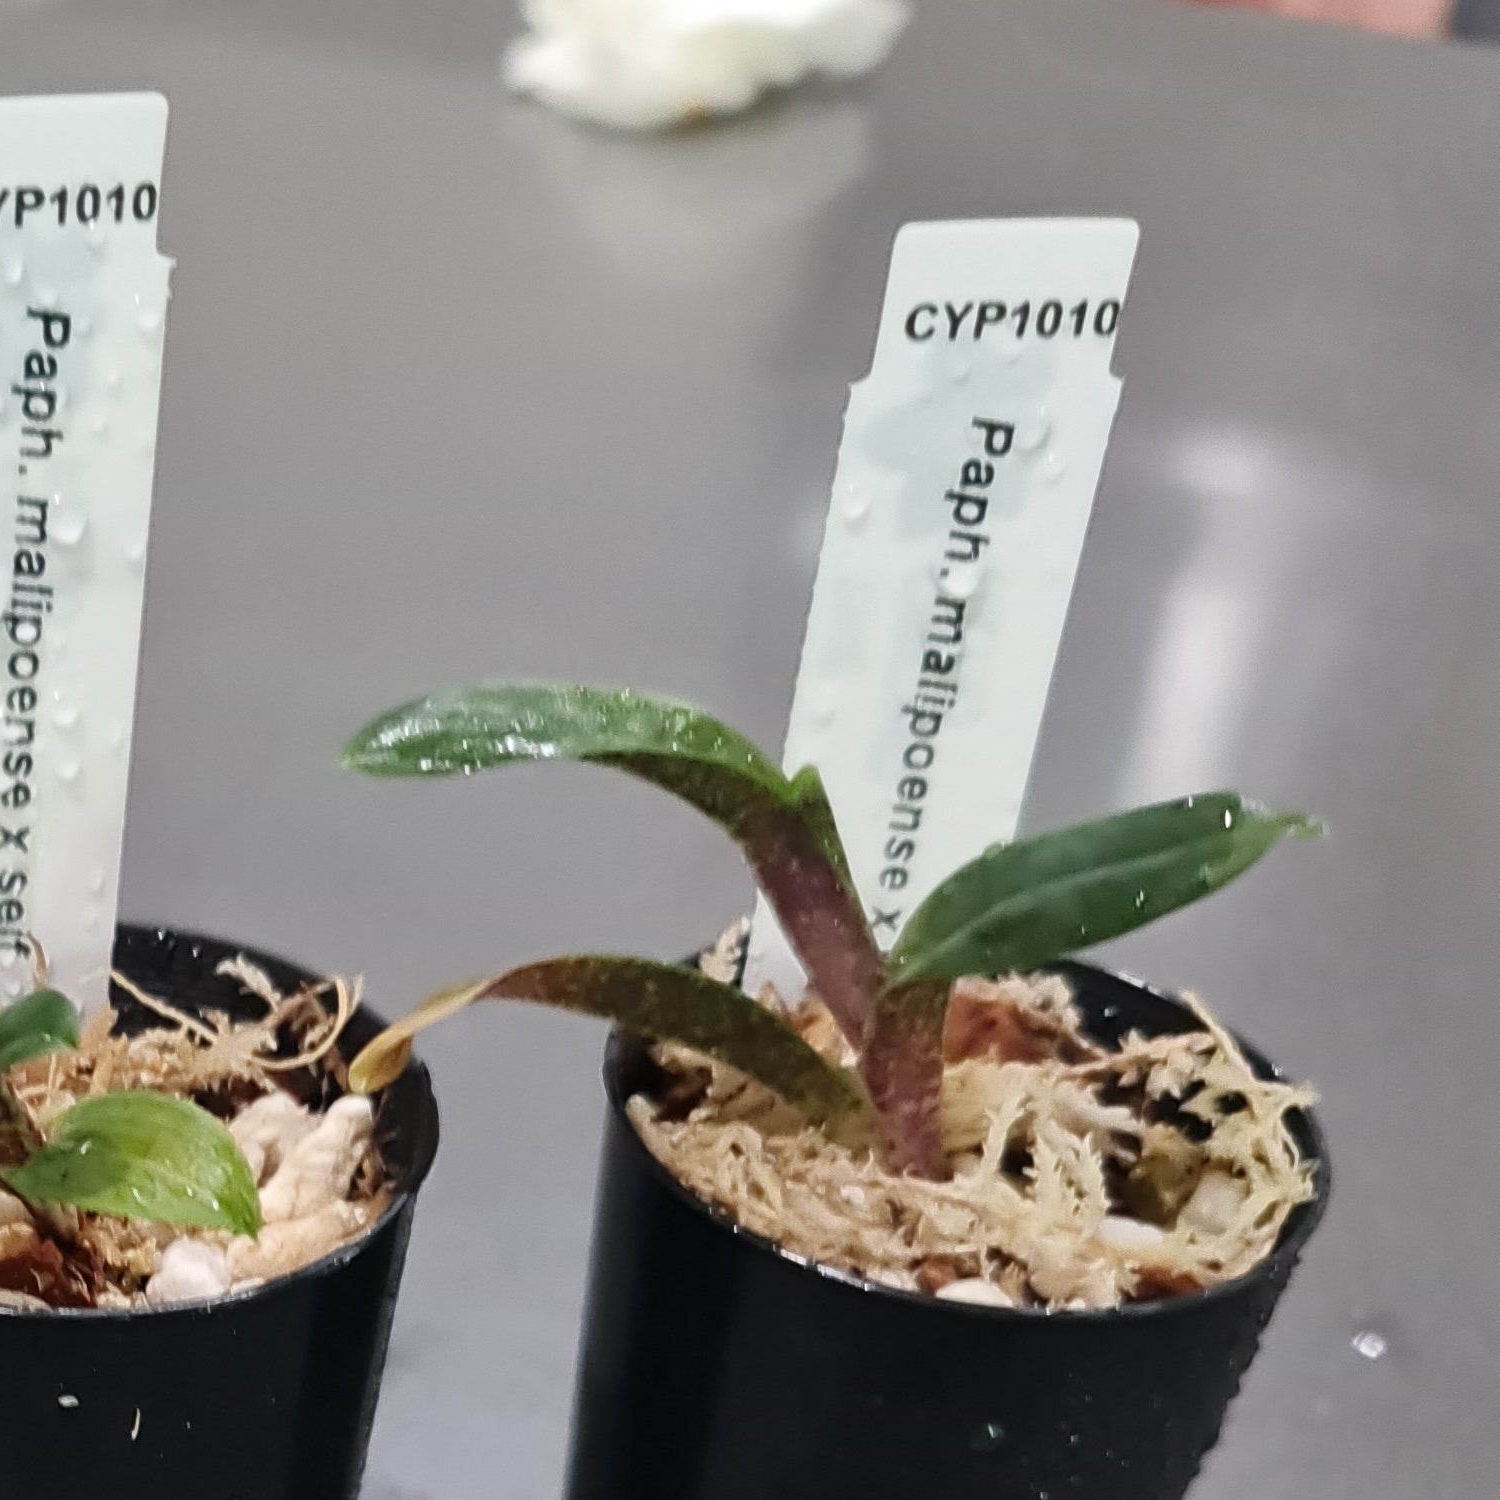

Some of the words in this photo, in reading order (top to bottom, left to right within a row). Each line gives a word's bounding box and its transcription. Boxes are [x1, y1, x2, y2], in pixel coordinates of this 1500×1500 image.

[11, 304, 71, 475] Paph.
[904, 298, 1121, 342] CYP1010
[944, 416, 1016, 578] Paph.
[0, 494, 55, 810] malipoense
[879, 595, 968, 891] malipoense
[872, 905, 902, 932] x
